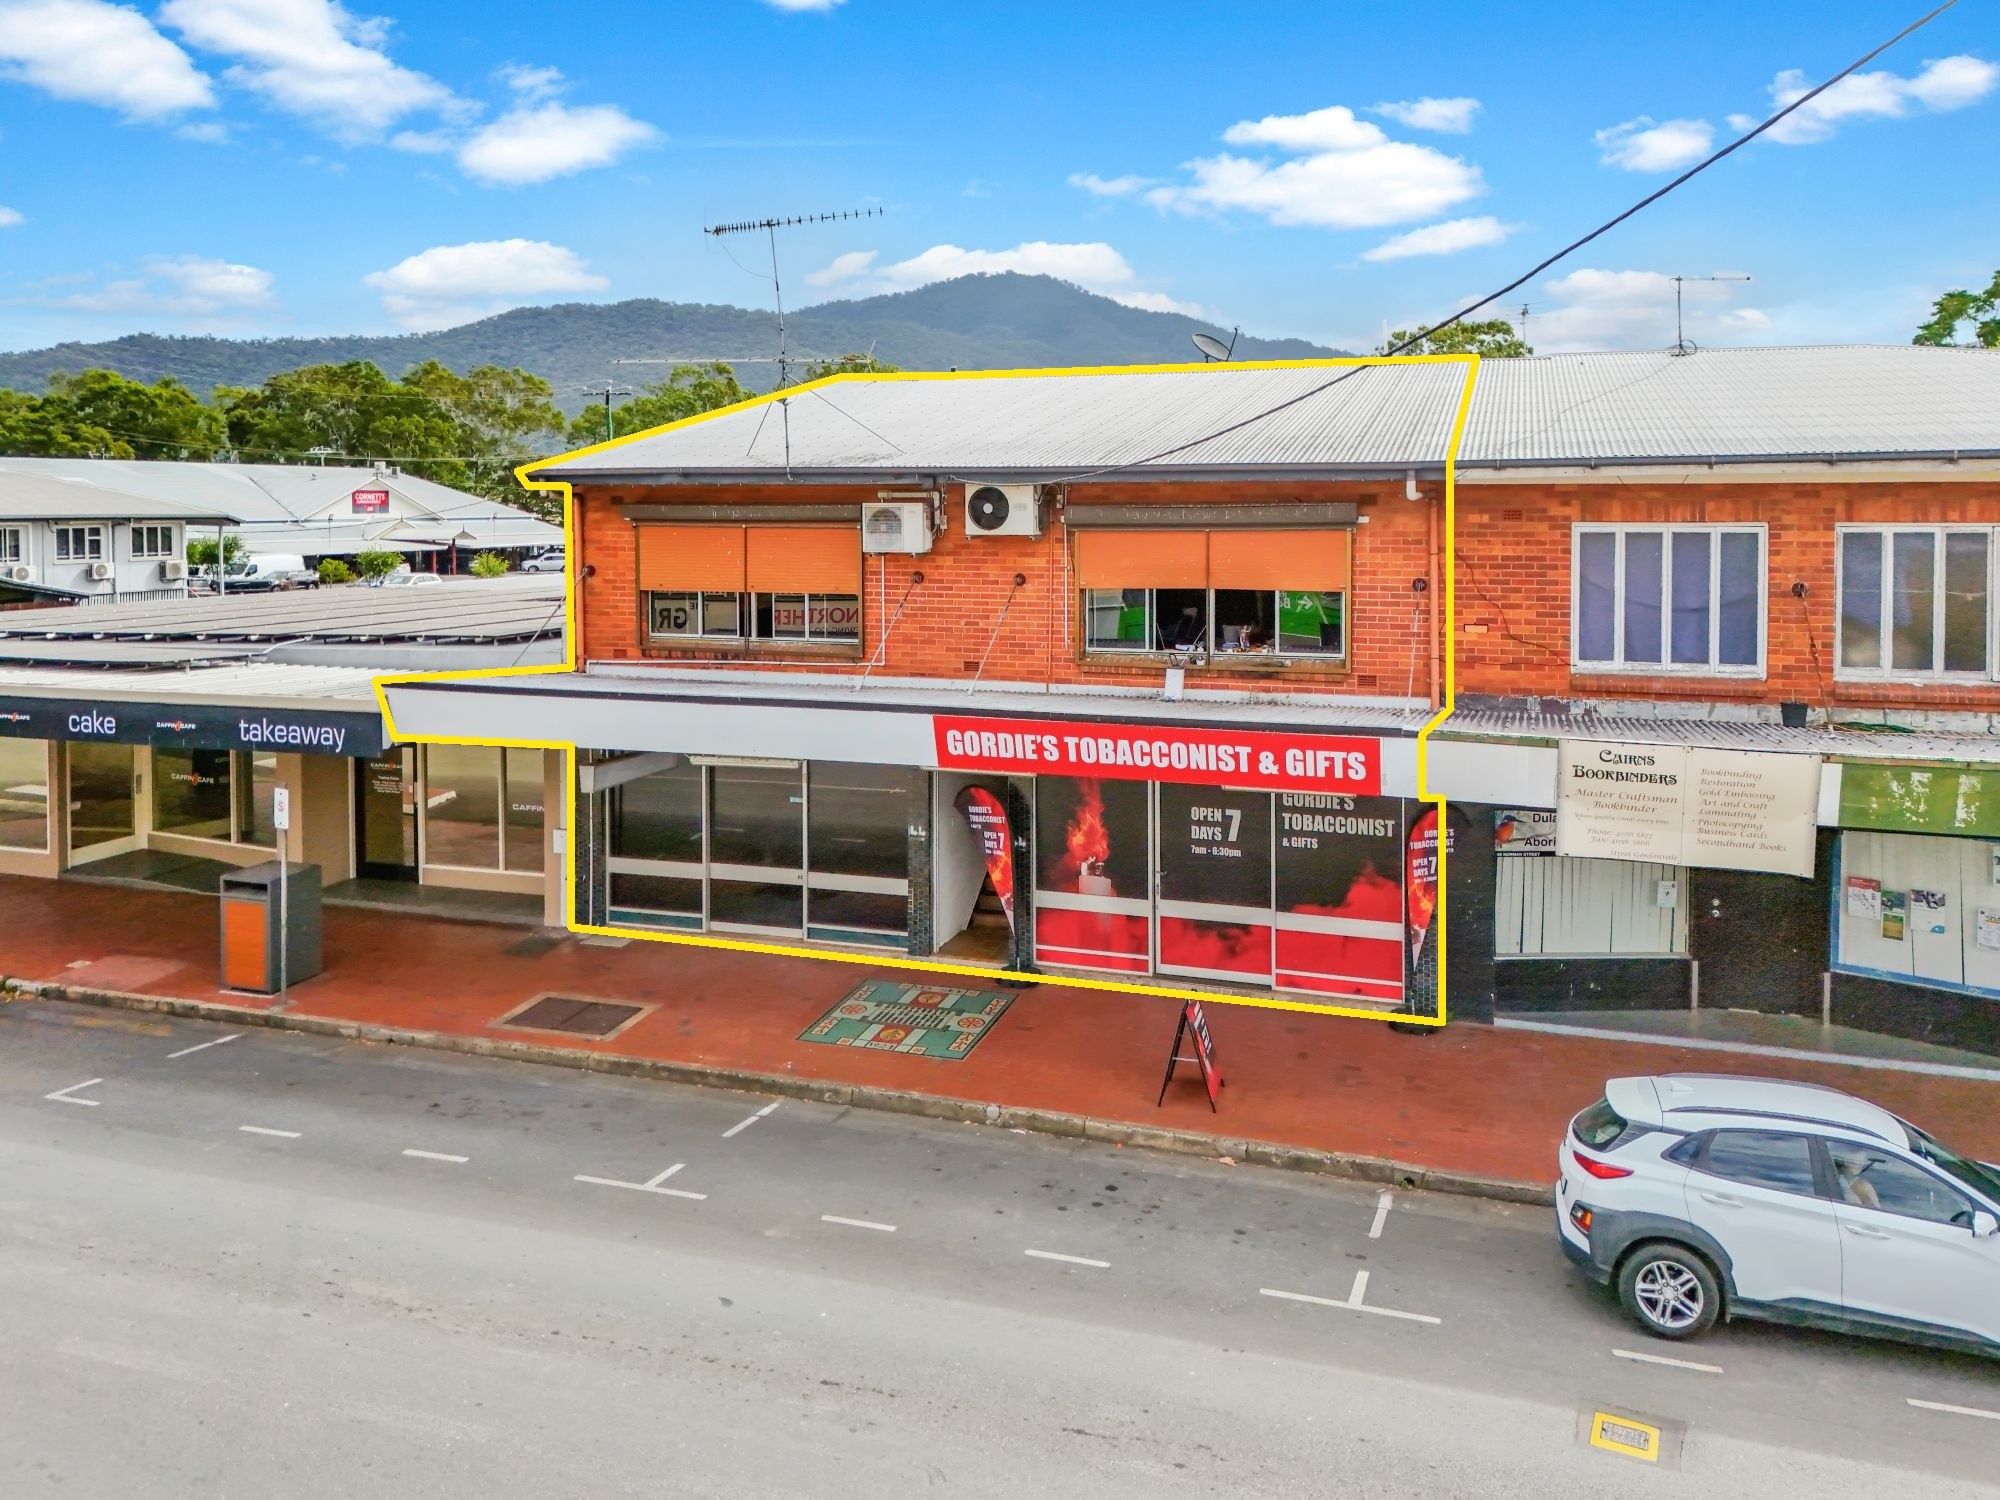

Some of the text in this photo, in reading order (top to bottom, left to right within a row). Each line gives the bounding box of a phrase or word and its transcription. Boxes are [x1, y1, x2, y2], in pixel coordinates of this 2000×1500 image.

[68, 709, 116, 734] cake
[239, 718, 345, 753] takeaway
[946, 729, 1367, 780] GORDIE'S TOBACCONIST & GIFTS
[1701, 768, 1762, 781] Bookbinding
[1700, 778, 1756, 789] Restoration
[1575, 788, 1678, 804] Master Craftsman
[1699, 788, 1720, 796] Gold
[1593, 800, 1659, 814] Bookbinder
[1703, 799, 1768, 810] Art and Craft
[1699, 809, 1757, 820] Laminating
[1191, 806, 1241, 842] OPEN 7
[1281, 812, 1395, 838] TOBACCONIST
[1697, 819, 1763, 831] Photocopying
[1191, 825, 1223, 841] DAYS
[1697, 828, 1737, 837] Business
[998, 832, 1005, 850] 7
[1282, 837, 1319, 849] & GIFTS
[1697, 838, 1786, 852] Secondhand Books
[1190, 845, 1207, 855] 7am
[1212, 847, 1242, 858] 6:30pm
[1412, 856, 1437, 874] OPEN 7
[1413, 868, 1429, 877] DAYS
